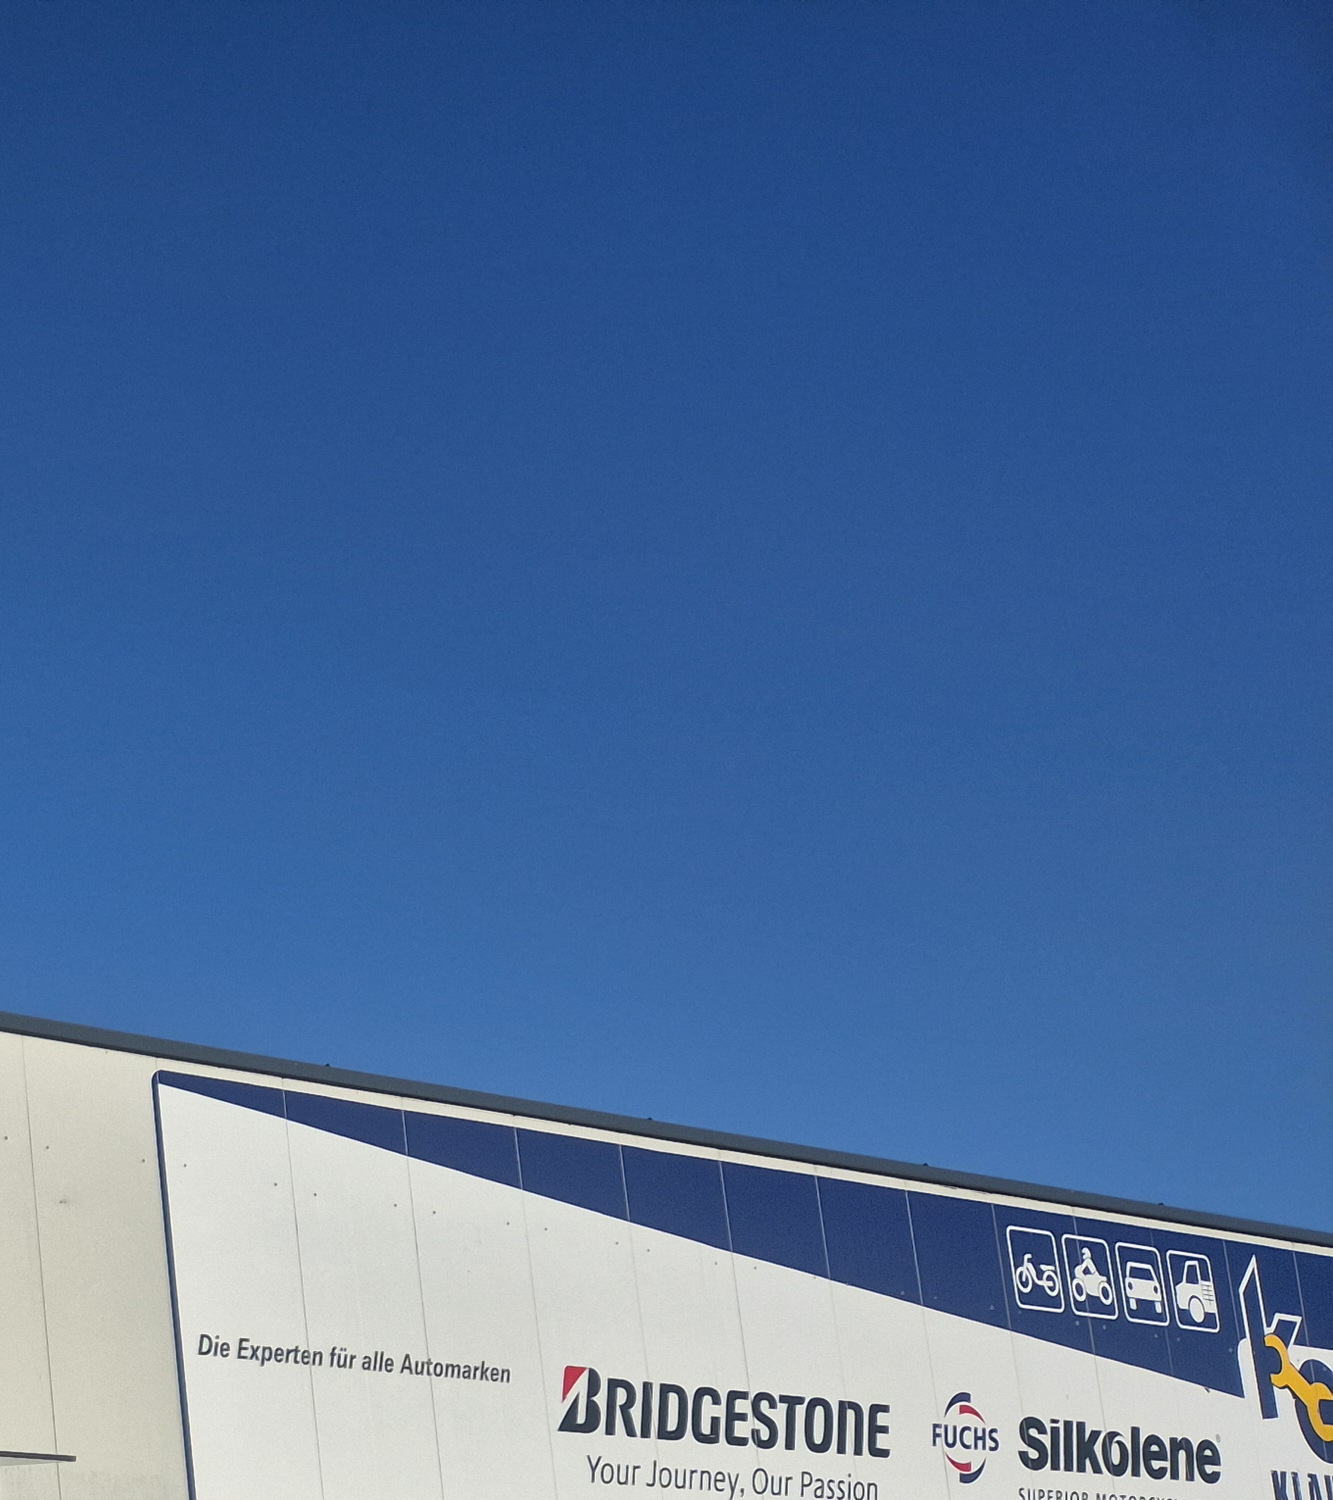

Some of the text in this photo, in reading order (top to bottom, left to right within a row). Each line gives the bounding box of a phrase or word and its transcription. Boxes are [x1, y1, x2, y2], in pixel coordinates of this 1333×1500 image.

[197, 1334, 511, 1384] Die Experten für alle Automarken
[557, 1365, 891, 1459] BRIDGESTONE
[932, 1423, 1000, 1452] FUCHS
[1018, 1415, 1222, 1485] Silkolene
[587, 1455, 641, 1487] Your
[751, 1467, 794, 1498] Our
